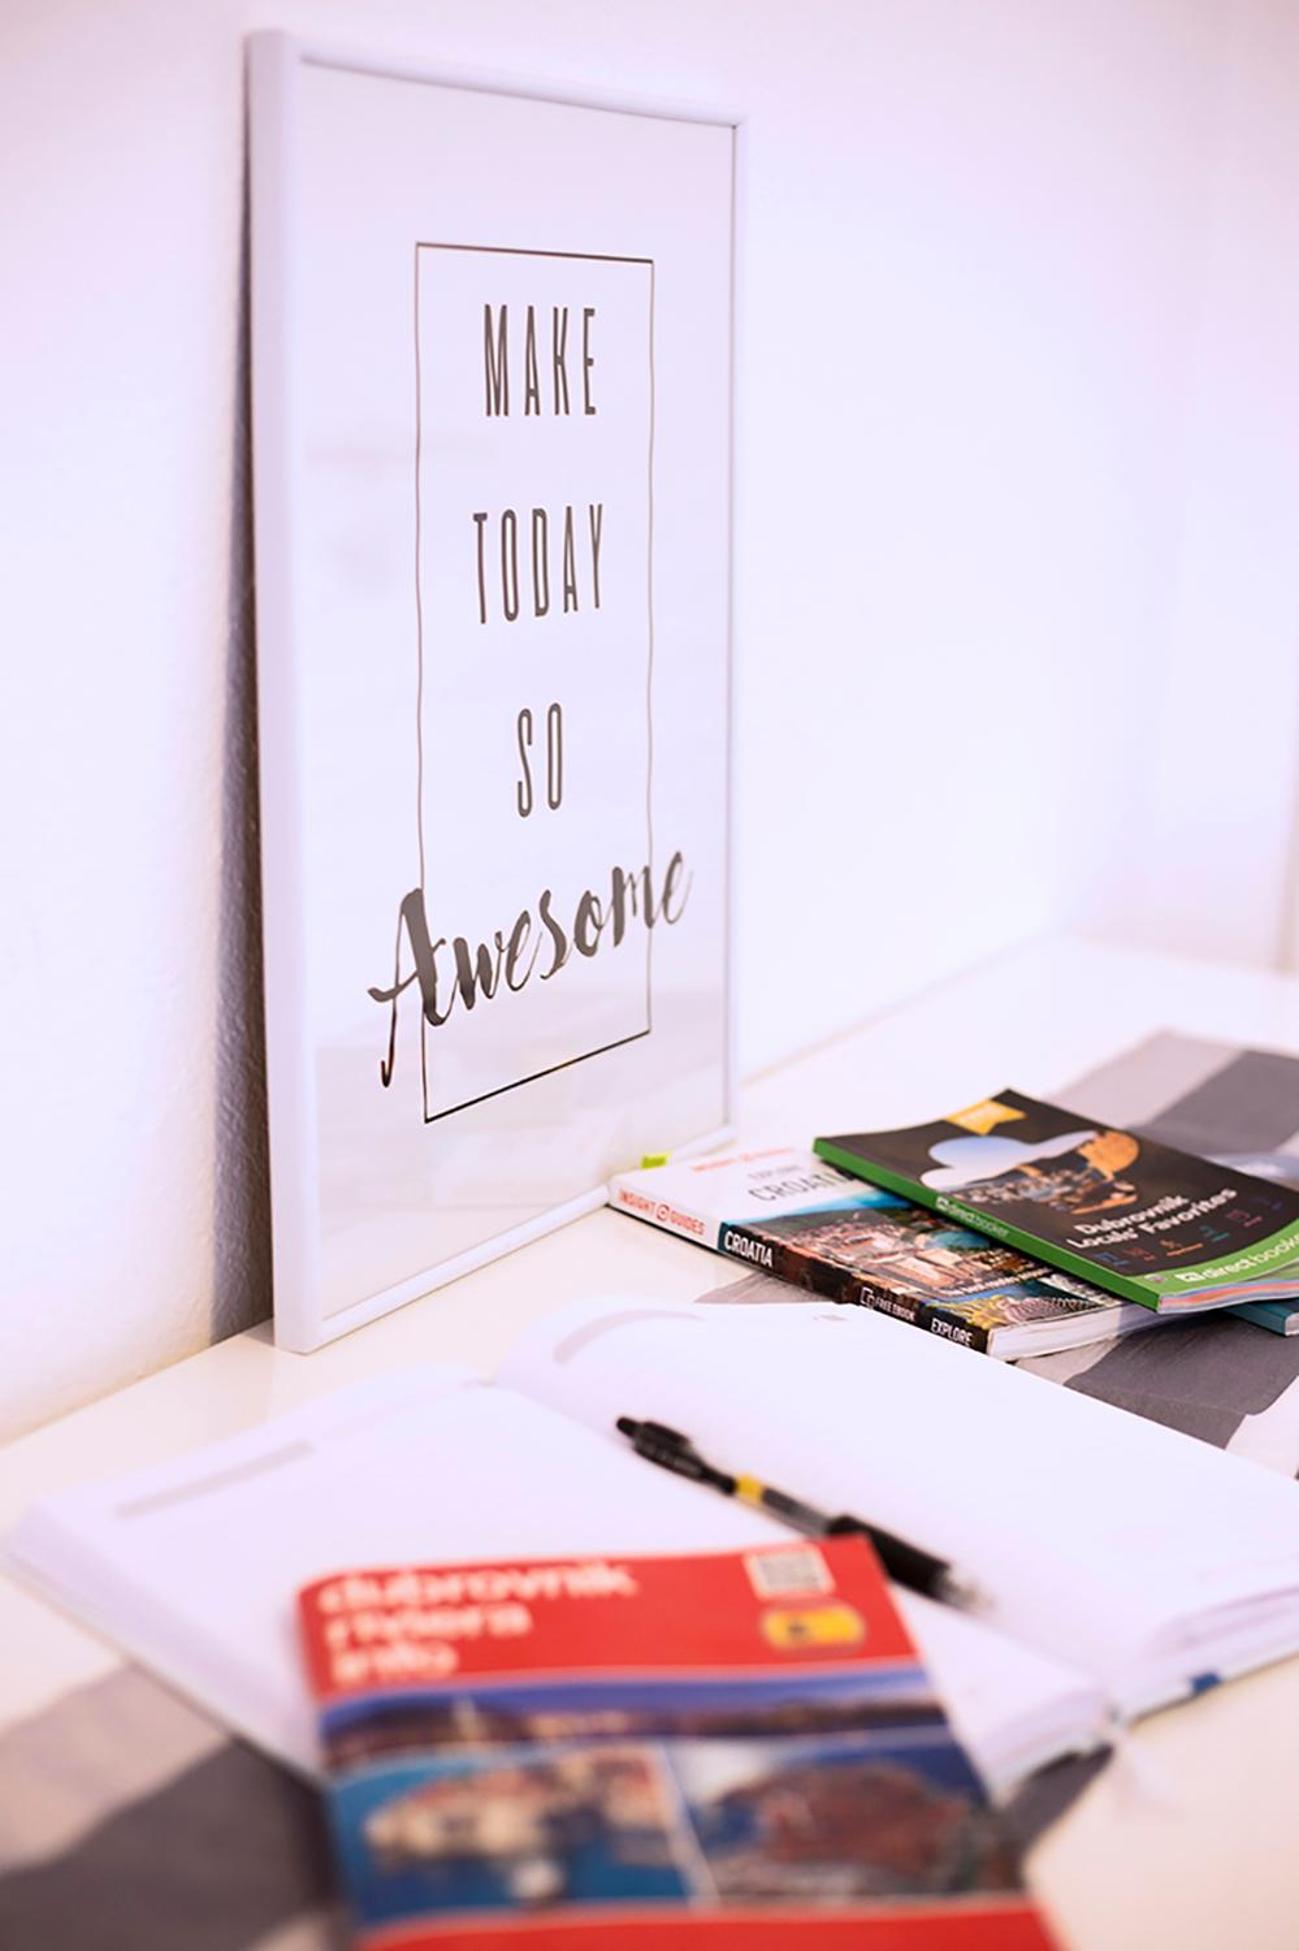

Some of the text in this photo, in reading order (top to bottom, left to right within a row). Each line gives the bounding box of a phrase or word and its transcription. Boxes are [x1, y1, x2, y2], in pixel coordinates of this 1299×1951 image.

[483, 304, 598, 417] MAKE
[473, 504, 602, 624] TODAY
[517, 703, 561, 817] SO
[367, 850, 694, 1088] Awesome
[747, 1172, 848, 1202] CROATI
[1138, 1187, 1238, 1235] Favorites
[618, 1188, 705, 1236] INSIGHT GUIDES
[1073, 1195, 1191, 1235] Dubrovnik
[723, 1230, 774, 1269] CROATIA
[930, 1317, 974, 1347] EXPLORE
[317, 1558, 640, 1615] dubrovnik
[324, 1601, 534, 1652] riviera
[330, 1640, 460, 1688] info
